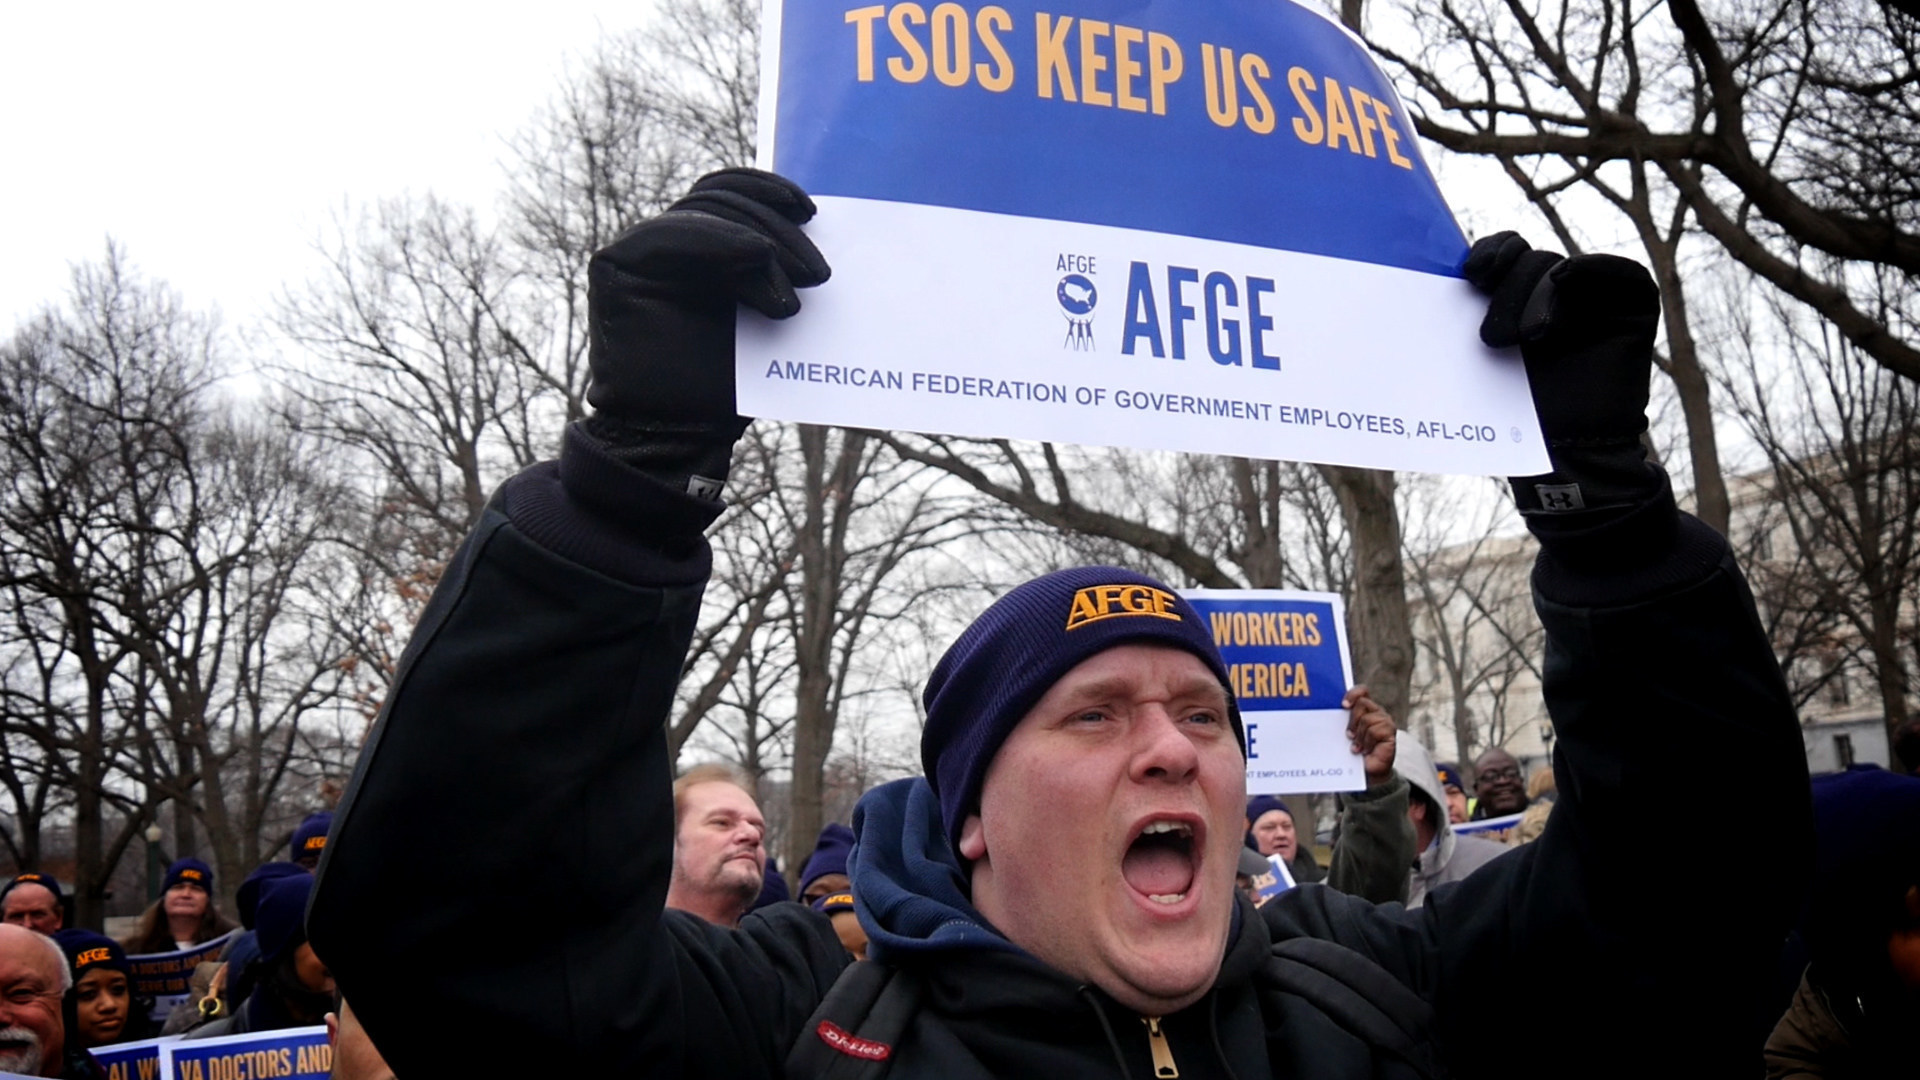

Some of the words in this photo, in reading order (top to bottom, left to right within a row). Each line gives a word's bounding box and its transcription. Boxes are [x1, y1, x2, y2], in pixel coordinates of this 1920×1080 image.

[845, 2, 1014, 92] TSOS
[1035, 13, 1183, 116] KEEP
[1201, 42, 1276, 135] US
[1287, 66, 1413, 170] SAFE
[1056, 253, 1097, 274] AFGE
[1121, 260, 1281, 371] AFGE
[765, 359, 903, 391] AMERICAN
[912, 372, 1067, 405] FEDERATION
[1075, 386, 1107, 407] OF
[1114, 389, 1272, 422] GOVERNMENT
[1280, 404, 1411, 439] EMPLOYEES,
[1416, 420, 1497, 443] AFL-CIO
[1066, 585, 1182, 631] AFGE
[1210, 611, 1321, 646] WORKERS
[1309, 767, 1343, 777] AFL-CIO
[76, 947, 112, 968] AFGE
[180, 1059, 203, 1080] VA
[209, 1048, 292, 1080] DOCTORS
[297, 1044, 333, 1074] AND
